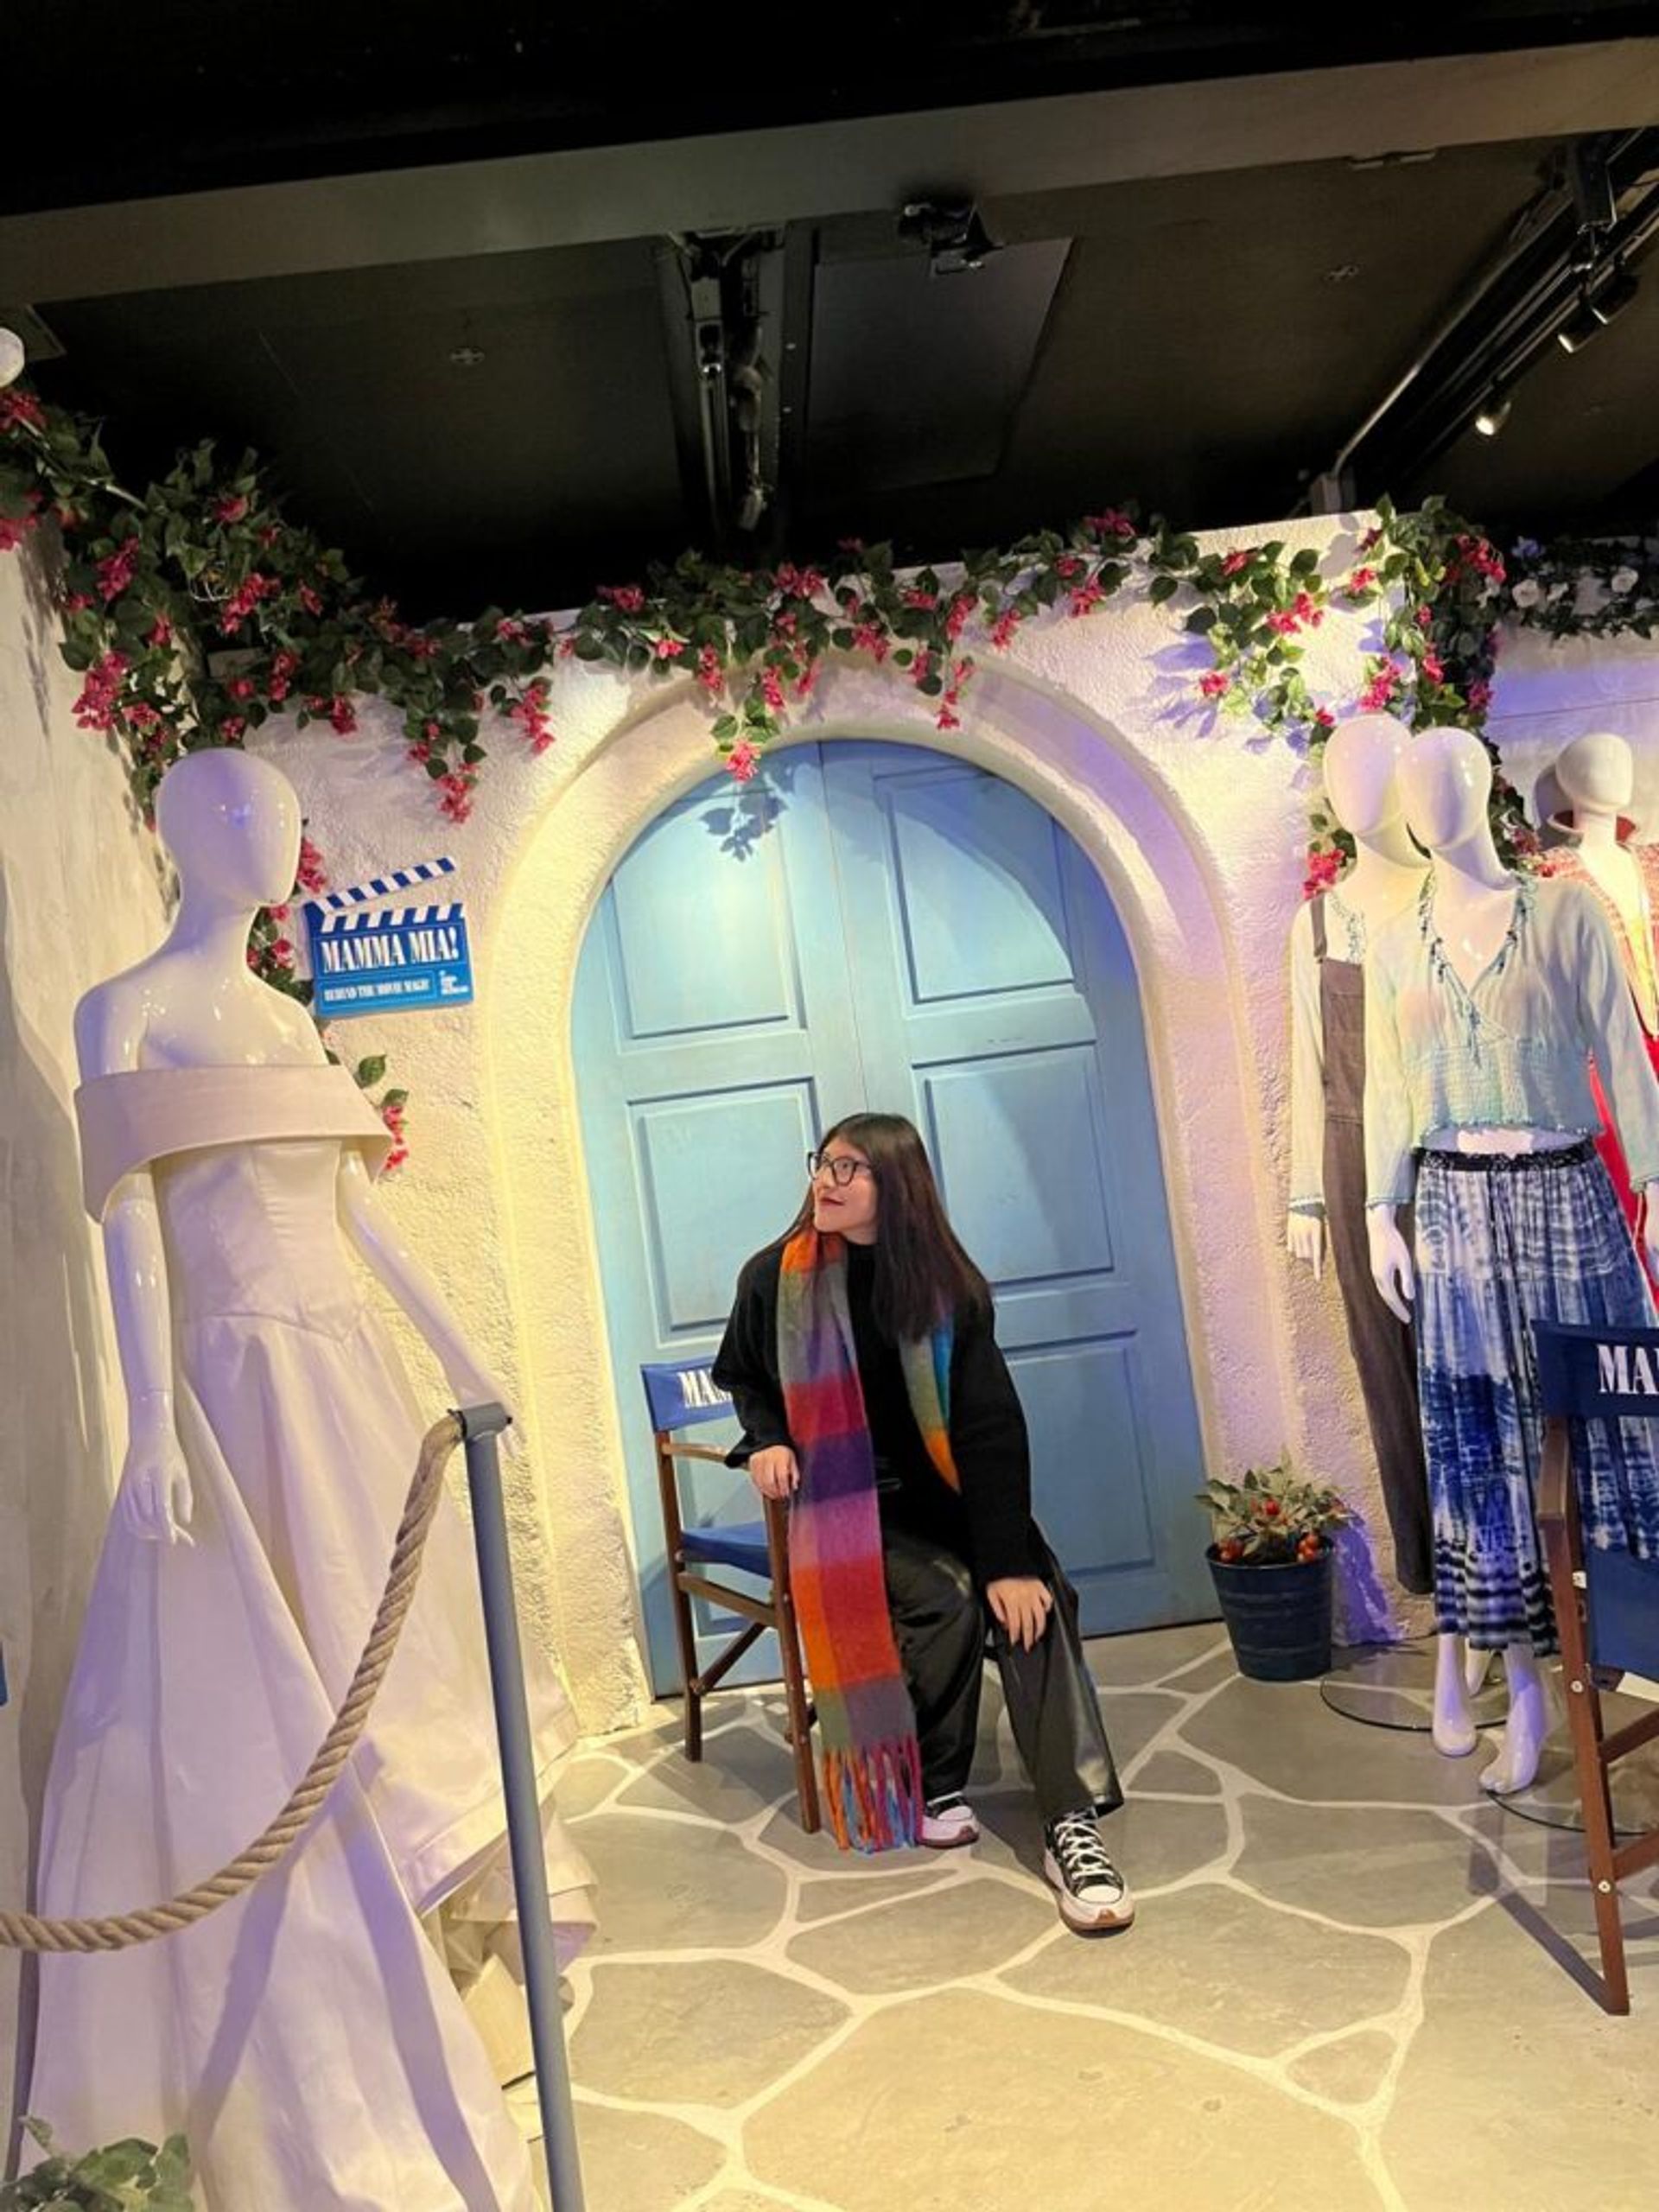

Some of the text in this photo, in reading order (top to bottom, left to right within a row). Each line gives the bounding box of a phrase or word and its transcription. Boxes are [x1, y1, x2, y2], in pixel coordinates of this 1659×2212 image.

[321, 927, 458, 974] MAMMA MIA!
[1596, 1343, 1659, 1395] MA
